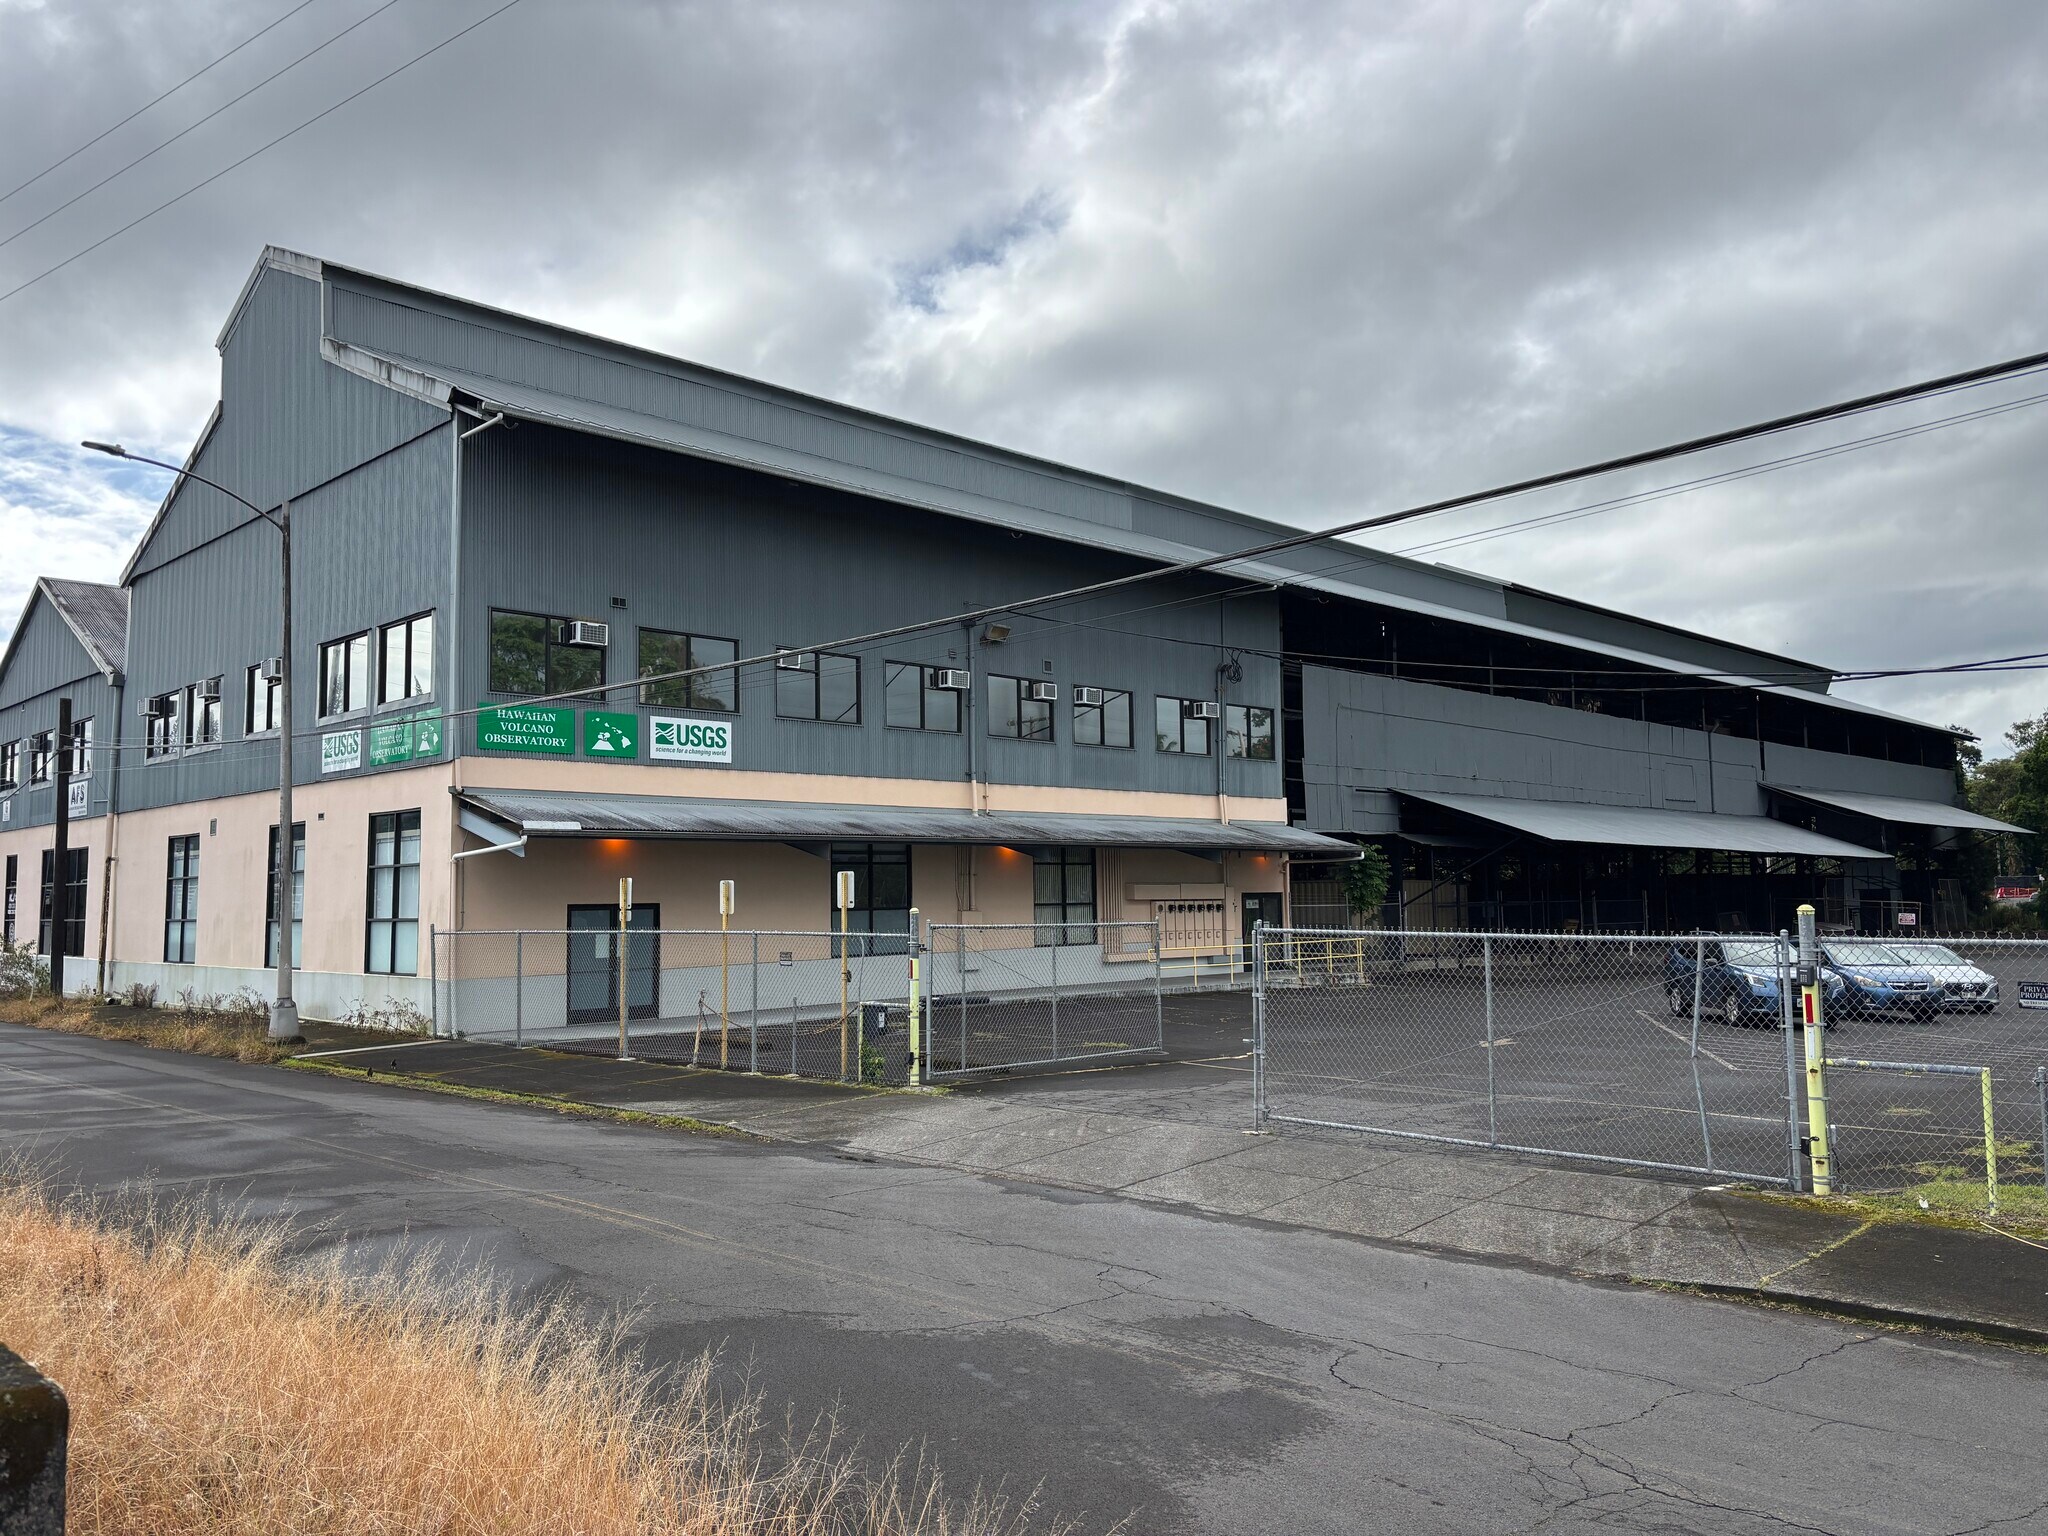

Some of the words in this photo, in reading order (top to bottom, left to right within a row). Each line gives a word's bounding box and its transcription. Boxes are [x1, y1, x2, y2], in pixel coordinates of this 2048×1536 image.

[497, 709, 556, 722] HAWAIIAN
[500, 722, 554, 734] VOLCANO
[485, 733, 567, 747] OBSERVATORY
[677, 724, 727, 748] USGS
[334, 731, 358, 757] USGS
[372, 745, 408, 758] OBSERVATORY
